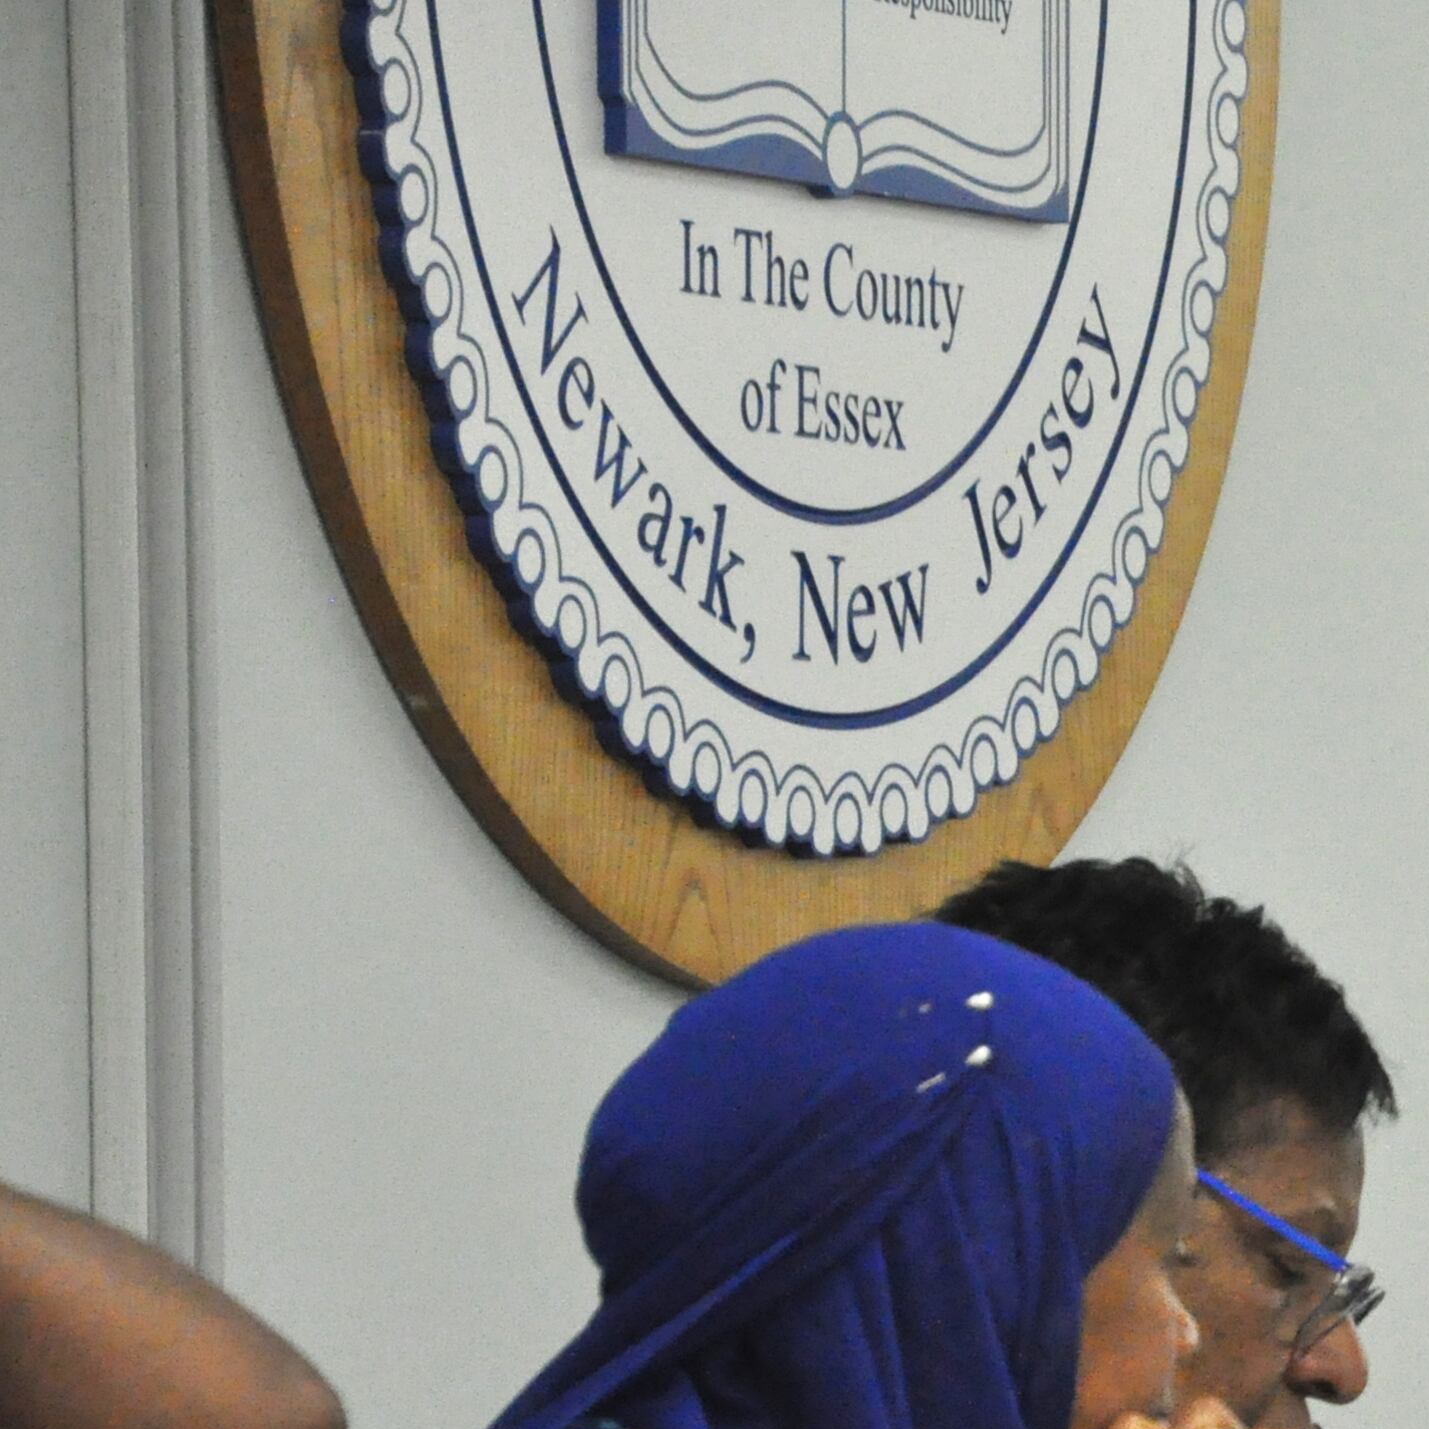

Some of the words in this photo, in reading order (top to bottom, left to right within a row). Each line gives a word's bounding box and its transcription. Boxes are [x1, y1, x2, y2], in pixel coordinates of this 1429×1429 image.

[680, 219, 721, 298] In
[734, 228, 809, 312] The
[823, 243, 965, 354] County
[512, 227, 757, 664] Newark,
[791, 550, 929, 665] New
[963, 285, 1120, 595] Jersey
[740, 358, 788, 434] of
[795, 364, 907, 451] Essex
